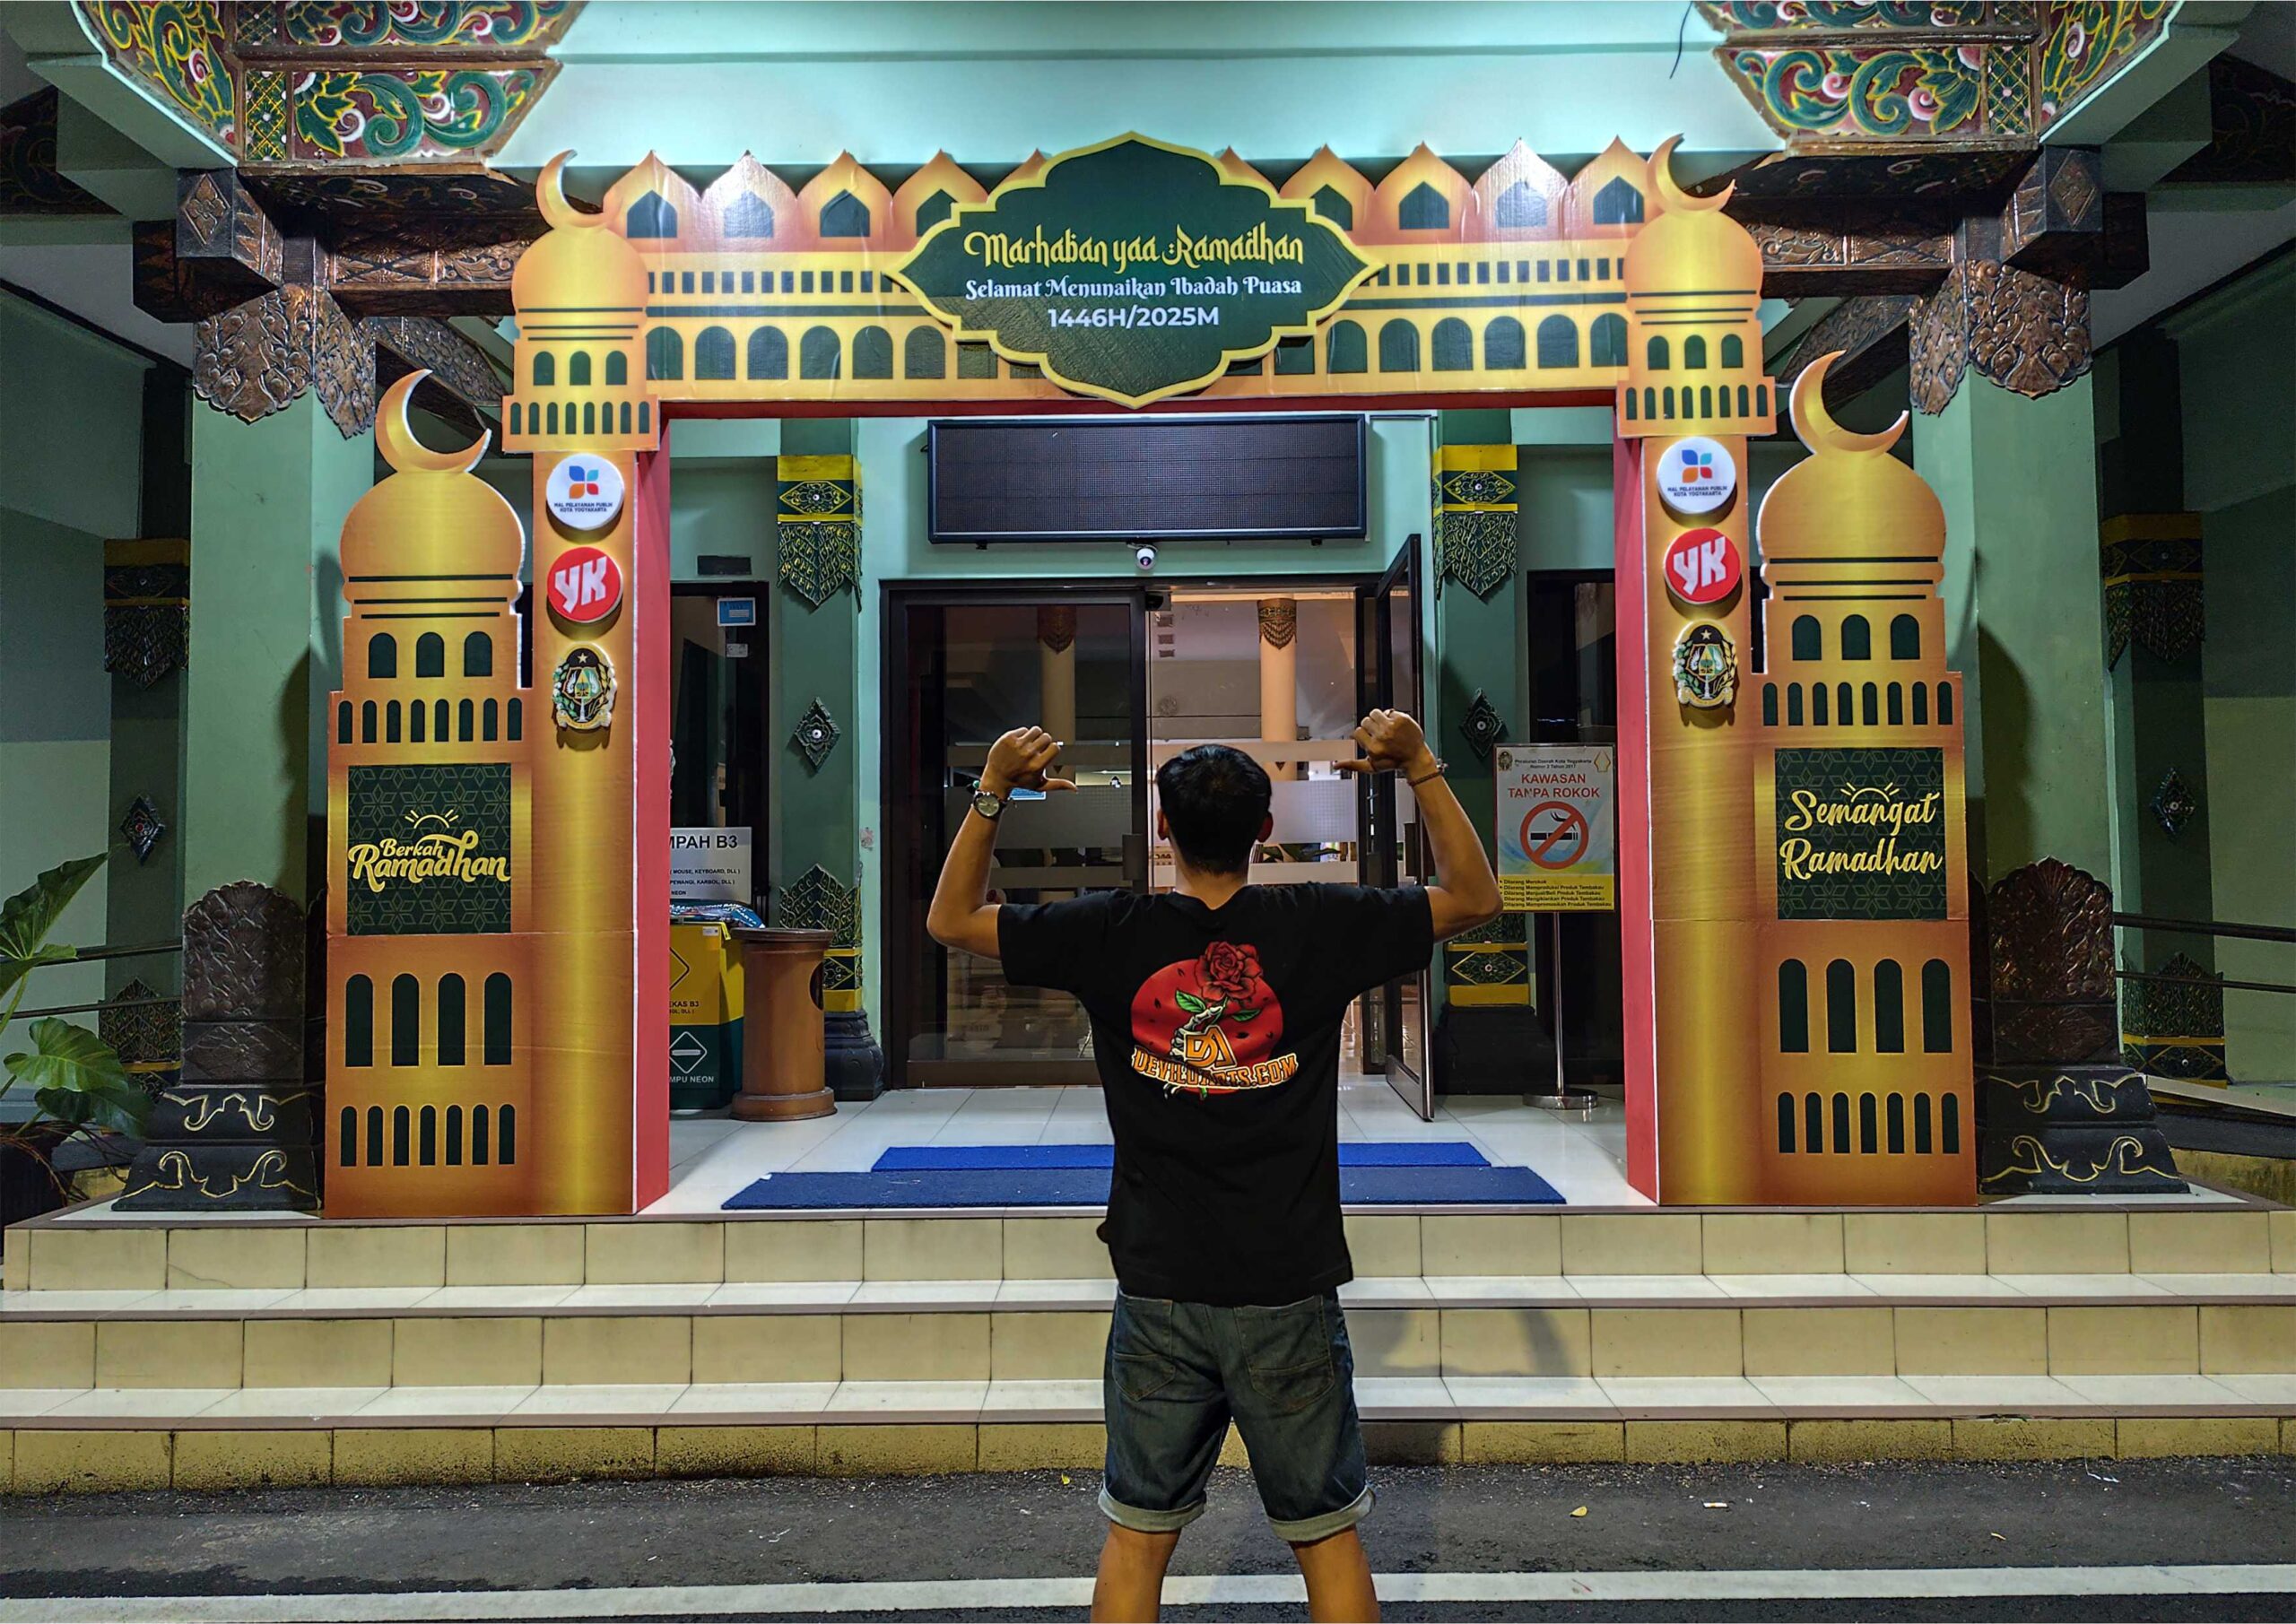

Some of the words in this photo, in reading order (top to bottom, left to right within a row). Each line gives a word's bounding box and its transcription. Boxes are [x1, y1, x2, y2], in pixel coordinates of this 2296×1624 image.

[963, 224, 1108, 268] Marhaban
[1113, 235, 1161, 274] yaa
[1161, 221, 1303, 269] Ramadhan
[965, 278, 1042, 300] Selamat
[1044, 274, 1166, 300] Menunaikan
[1170, 276, 1239, 296] Ibadah
[1243, 275, 1302, 294] Puasa
[1048, 305, 1220, 329] 1446H/2025M
[1674, 536, 1726, 595] YK
[554, 556, 607, 614] YK
[1521, 773, 1586, 784] KAWASAN
[1552, 787, 1600, 798] ROKOK
[1784, 789, 1941, 836] Semangat
[379, 834, 444, 859] Berkah
[717, 835, 738, 848] B3
[348, 829, 511, 893] Ramadhan
[1779, 838, 1943, 880] Ramadhan
[690, 1075, 715, 1083] NEON
